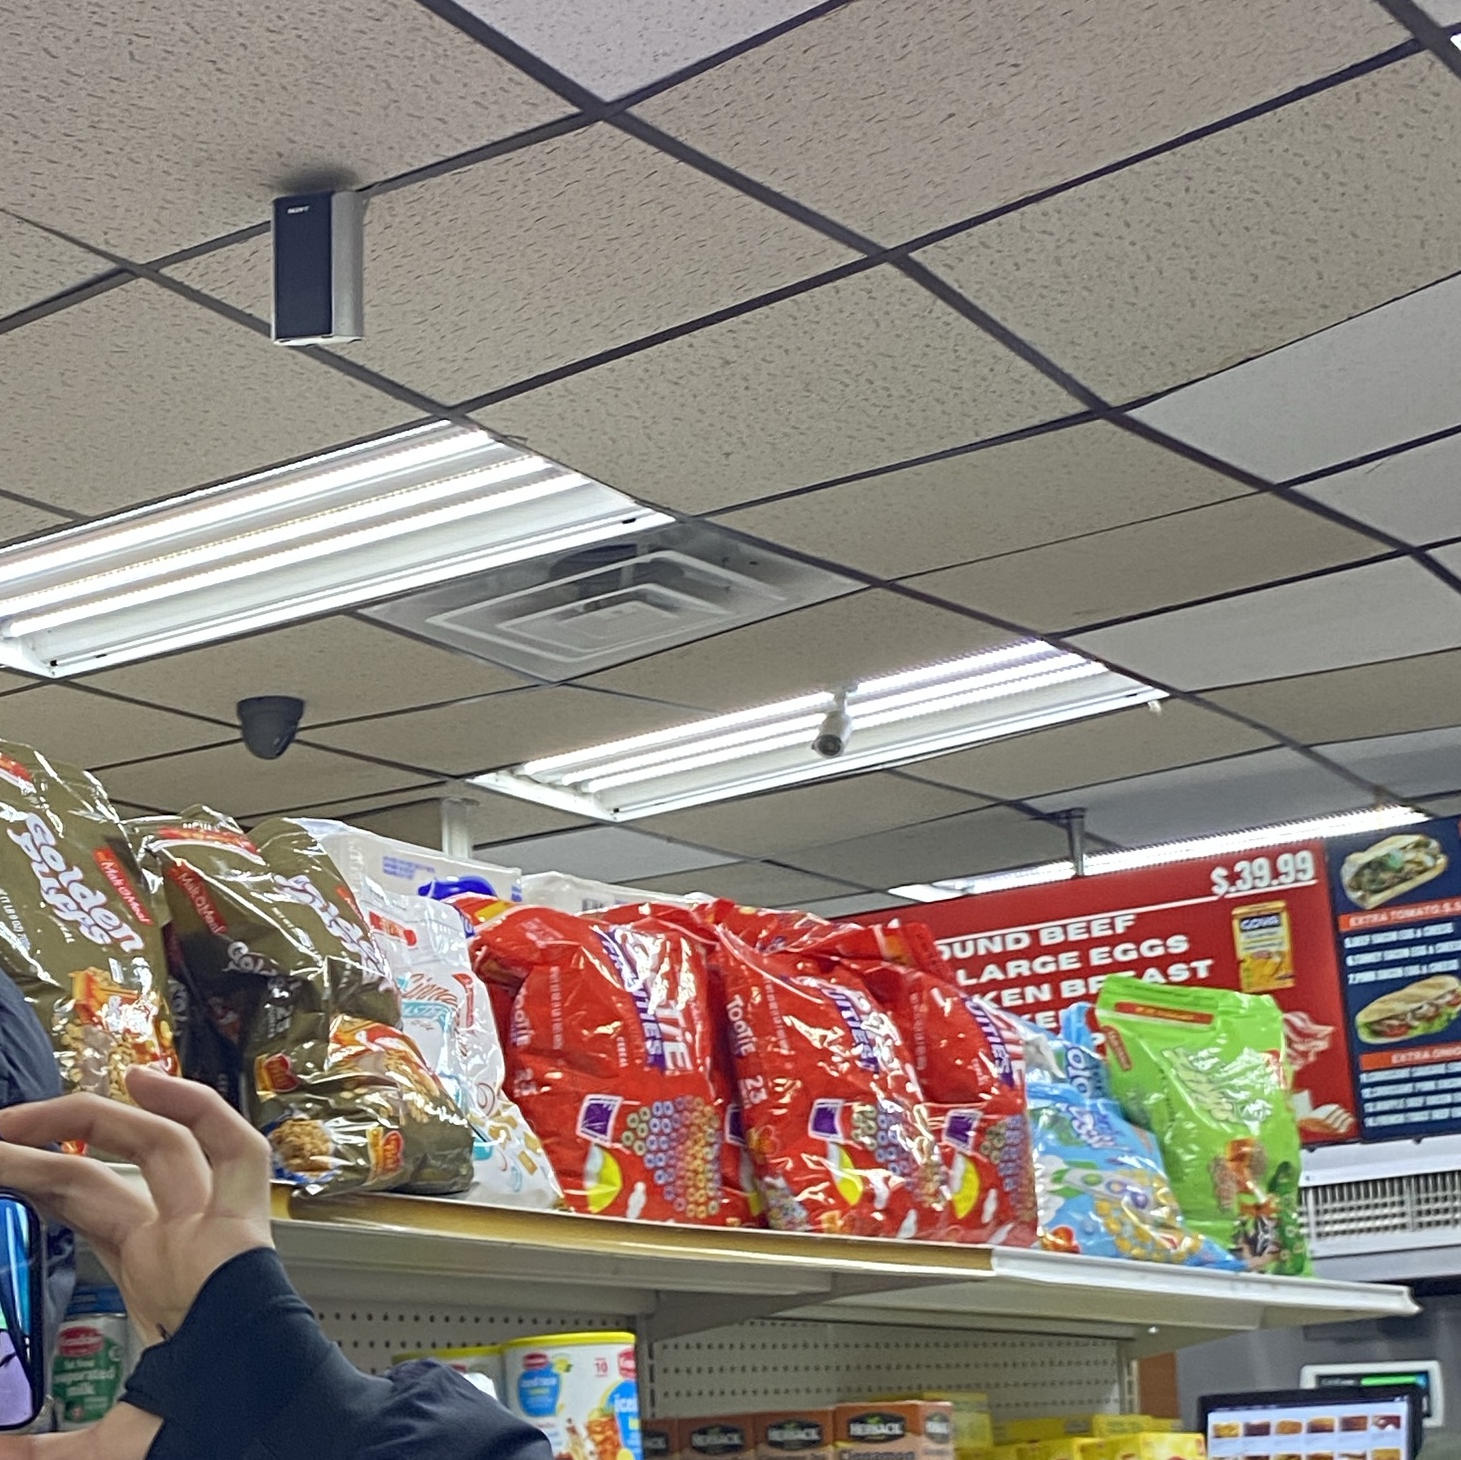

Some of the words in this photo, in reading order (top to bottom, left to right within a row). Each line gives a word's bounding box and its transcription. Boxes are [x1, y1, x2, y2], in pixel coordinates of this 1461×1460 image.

[7, 828, 113, 946] Puffs
[26, 812, 144, 953] Golden
[1211, 850, 1315, 896] $.39.99
[937, 933, 1031, 961] OUND
[1040, 914, 1137, 946] BEEF
[955, 950, 1081, 986] LARGE
[1089, 935, 1189, 967] EGGS
[982, 982, 1060, 1010] KEN
[1061, 959, 1214, 998] BRAST
[726, 993, 757, 1056] TOOTIE
[821, 987, 875, 1070] UITIES
[966, 999, 1011, 1074] UITIES
[745, 1075, 768, 1104] 23
